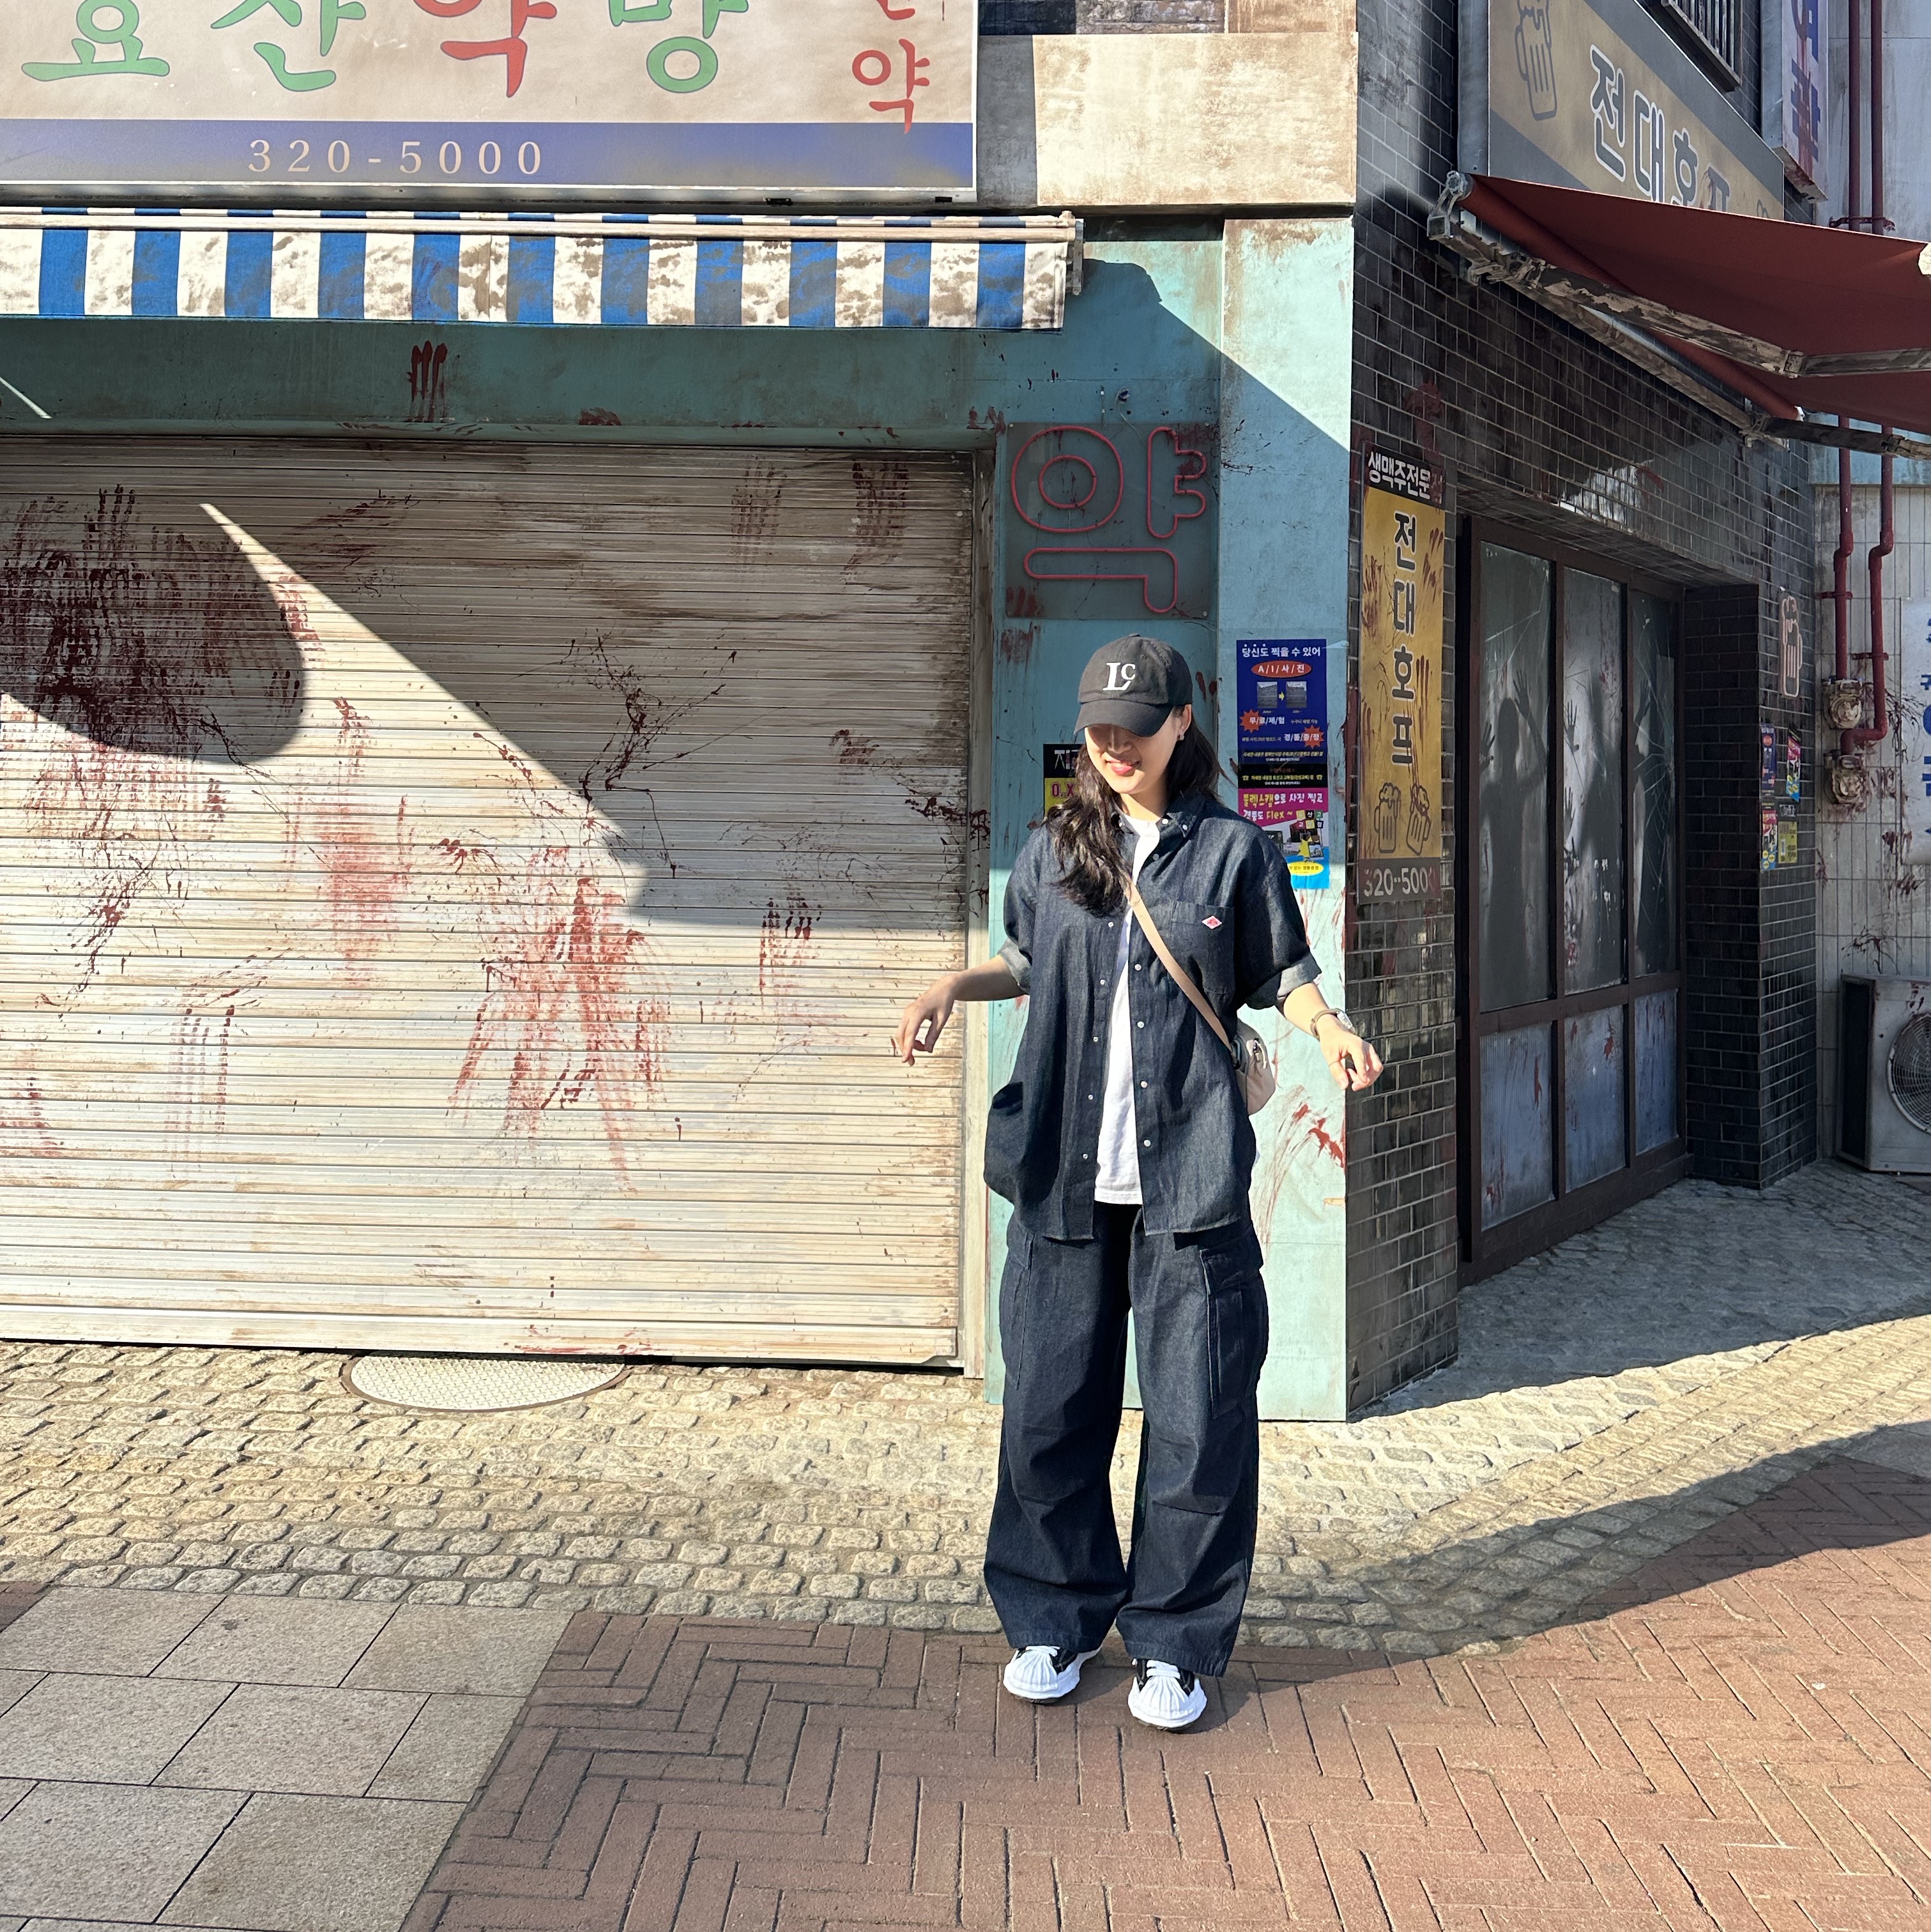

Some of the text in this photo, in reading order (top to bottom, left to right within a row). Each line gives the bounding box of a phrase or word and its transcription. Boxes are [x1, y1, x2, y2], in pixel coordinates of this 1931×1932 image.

[248, 140, 542, 174] 320-5000
[1011, 425, 1207, 614] 약
[1242, 646, 1321, 657] 당신도 찍을 수 있어
[1392, 509, 1418, 767] 전대호프
[1288, 793, 1305, 803] 사진
[1308, 793, 1323, 803] 찍고
[1266, 810, 1285, 820] Flex
[1364, 867, 1434, 897] 320-500
